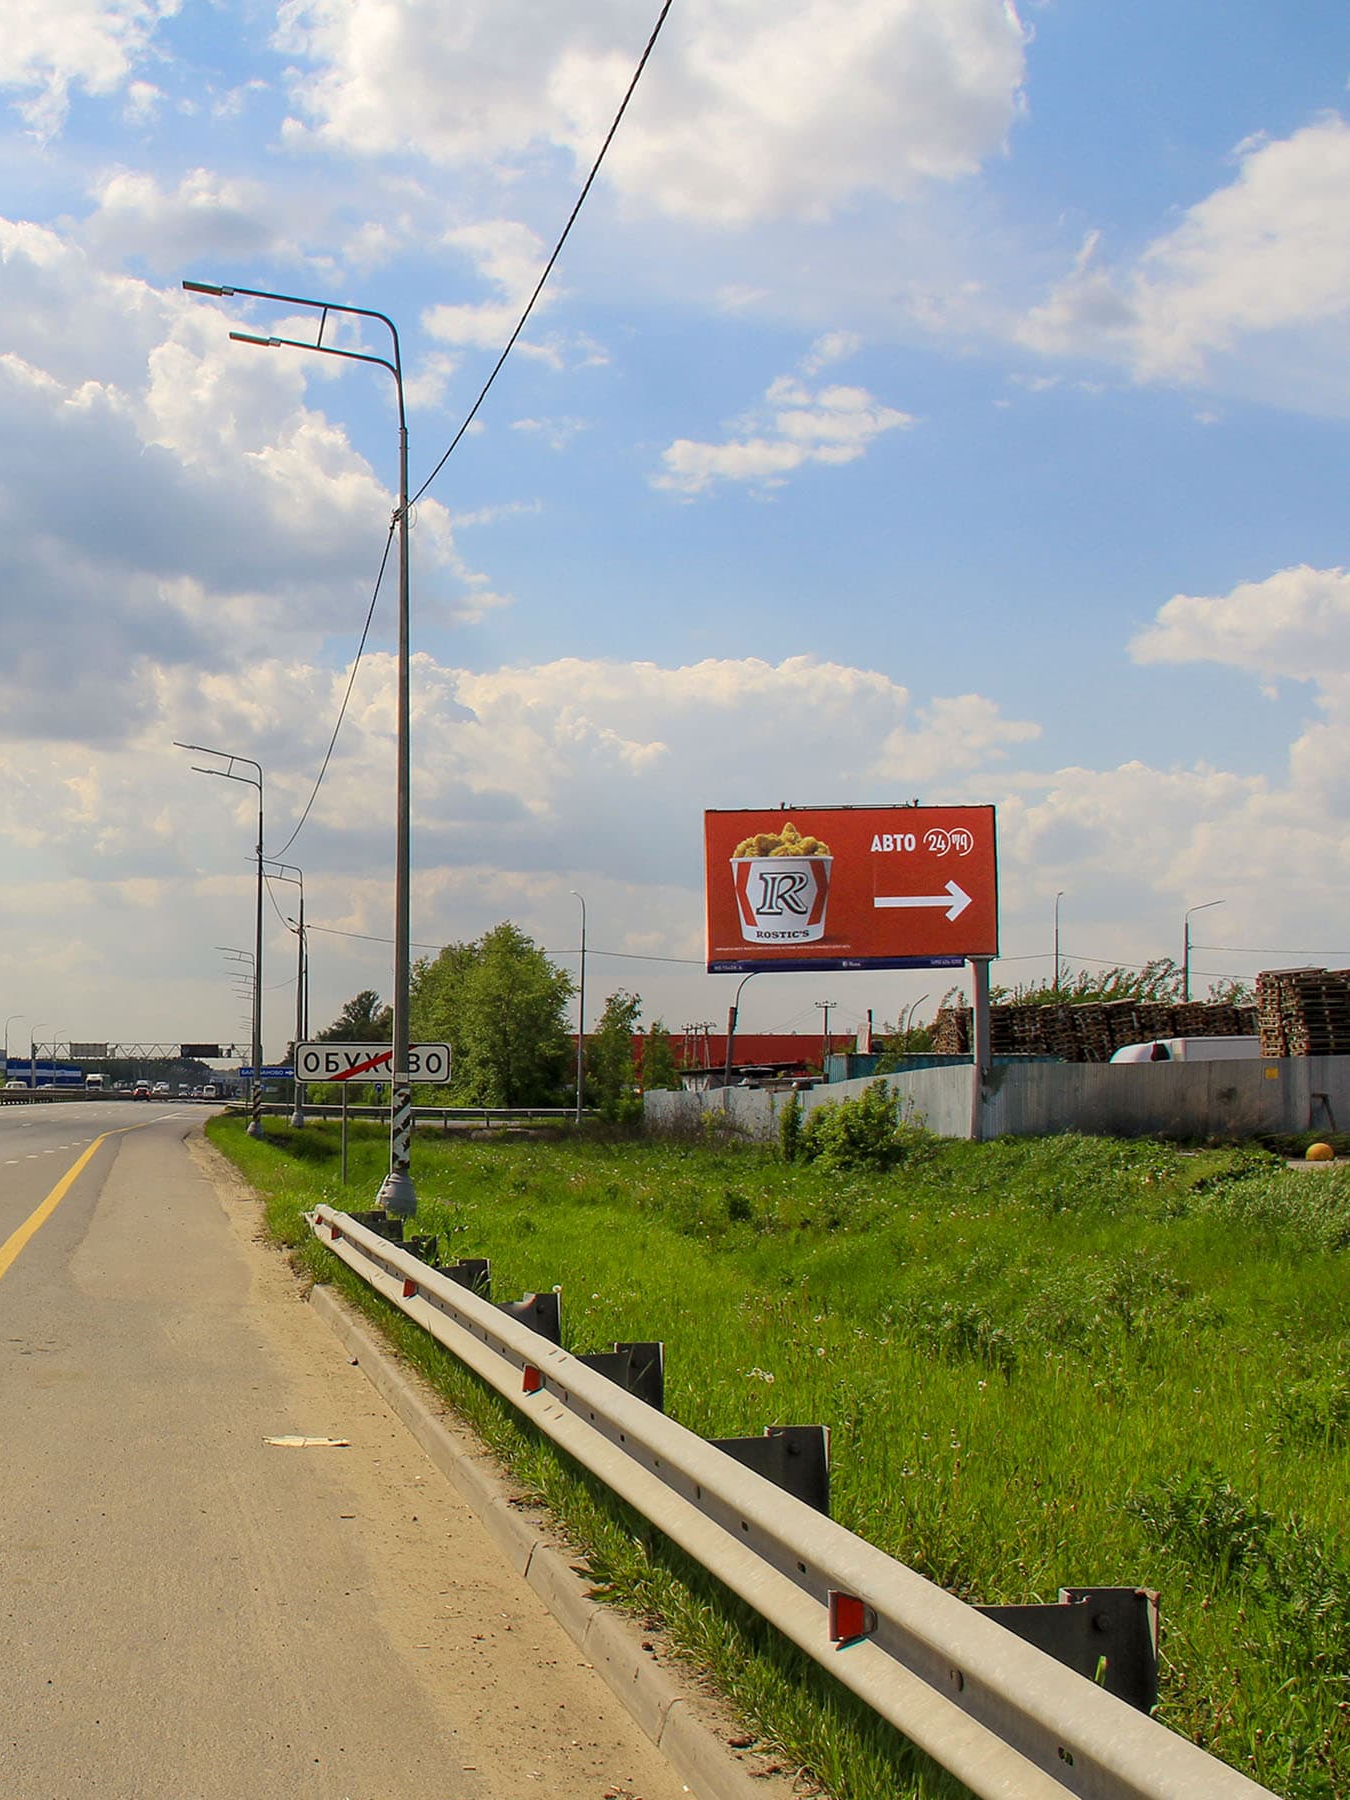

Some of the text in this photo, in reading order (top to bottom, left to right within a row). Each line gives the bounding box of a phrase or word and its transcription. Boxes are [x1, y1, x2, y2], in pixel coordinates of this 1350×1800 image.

[871, 834, 916, 852] АВТО
[756, 872, 808, 915] R
[756, 929, 810, 939] ROSTIC'S
